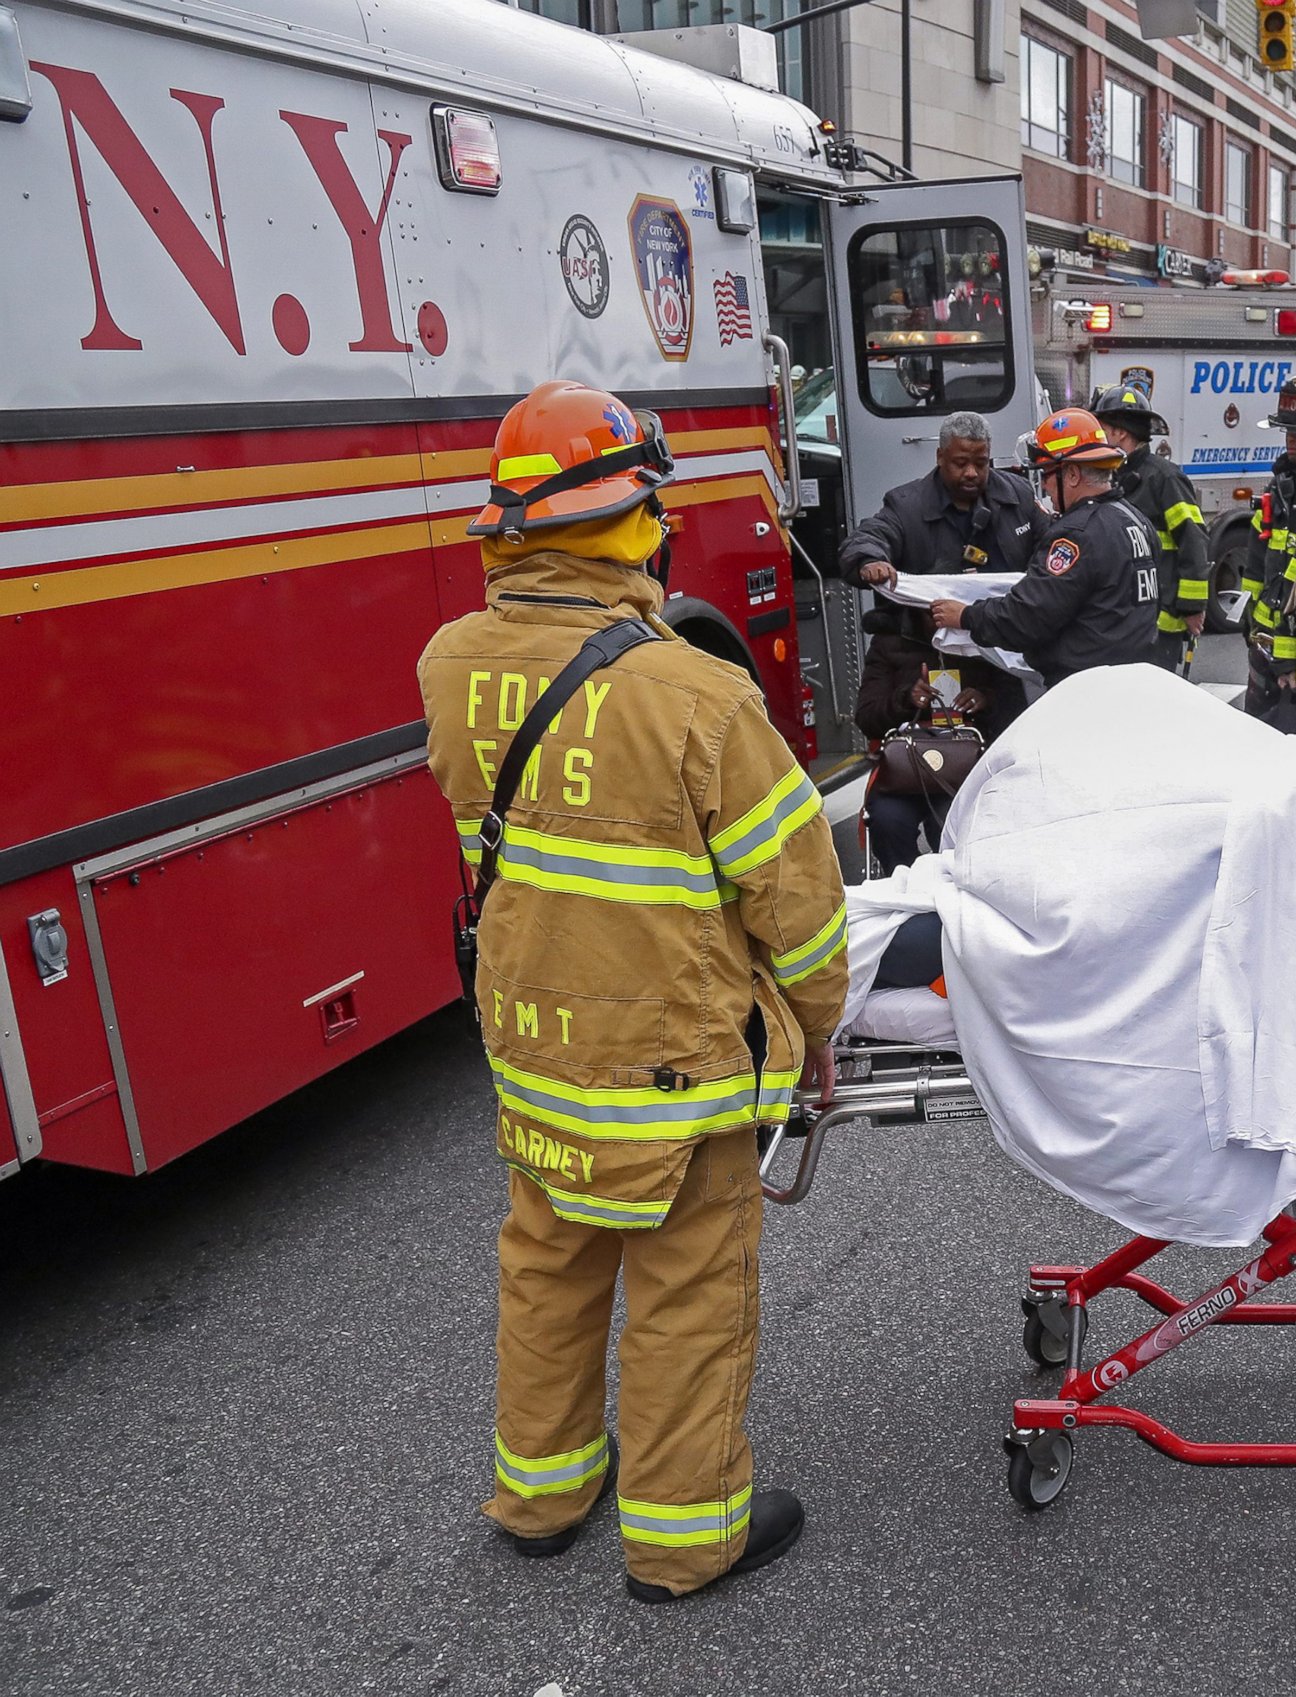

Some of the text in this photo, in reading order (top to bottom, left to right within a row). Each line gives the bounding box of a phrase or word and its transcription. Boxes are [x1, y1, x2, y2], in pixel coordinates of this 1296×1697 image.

[30, 61, 448, 357] N.Y.
[692, 208, 714, 219] CERTIFIED
[646, 239, 679, 253] NEW YORK
[649, 225, 673, 238] CITY OF
[1191, 361, 1292, 393] POLICE
[1191, 446, 1288, 463] EMERGENCY SERVIC
[1015, 522, 1031, 536] FDNY
[1126, 525, 1151, 558] FDN
[493, 988, 573, 1045] EMT
[501, 1115, 594, 1183] CARNEY
[1177, 1286, 1237, 1336] FERNO
